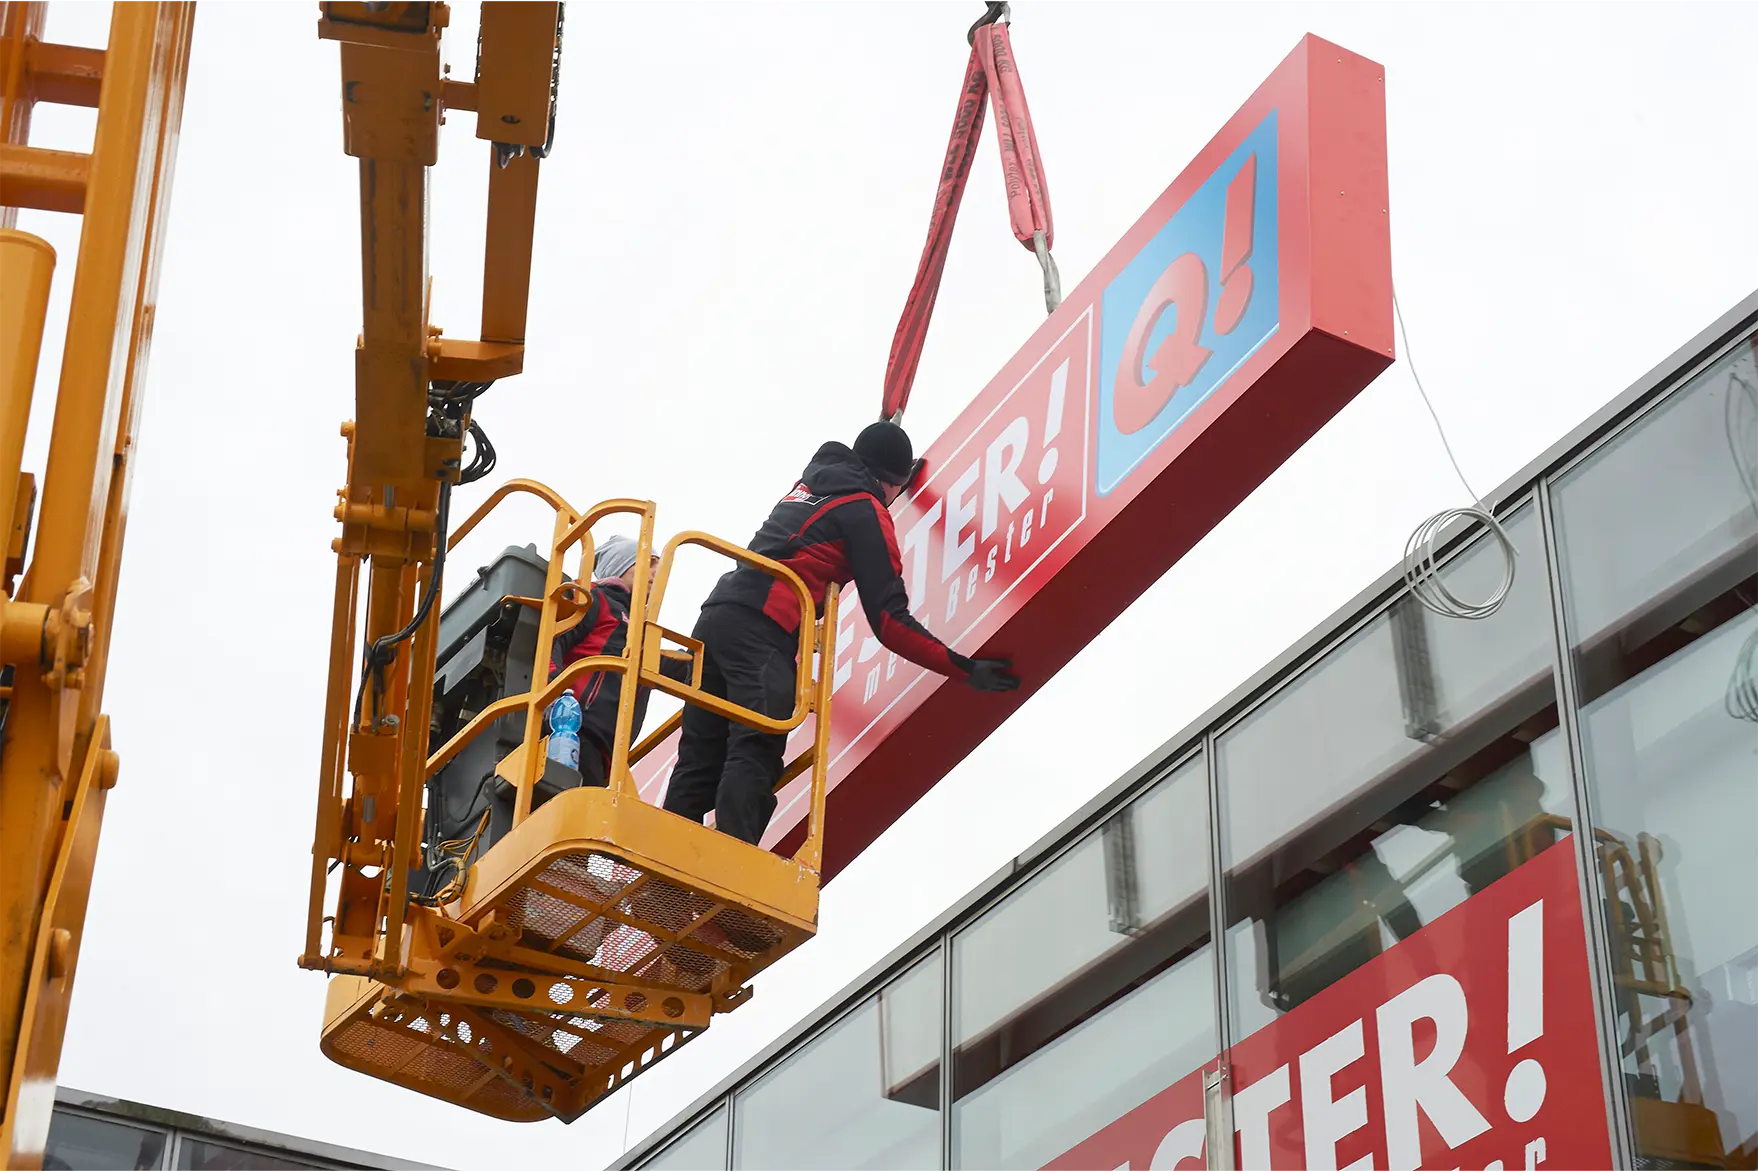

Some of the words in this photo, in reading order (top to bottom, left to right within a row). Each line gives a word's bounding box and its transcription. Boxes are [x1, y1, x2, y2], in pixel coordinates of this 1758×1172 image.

[1113, 150, 1256, 435] Q!
[787, 357, 1069, 742] ETER!
[945, 488, 1053, 624] Bester
[1112, 898, 1547, 1172] TER!
